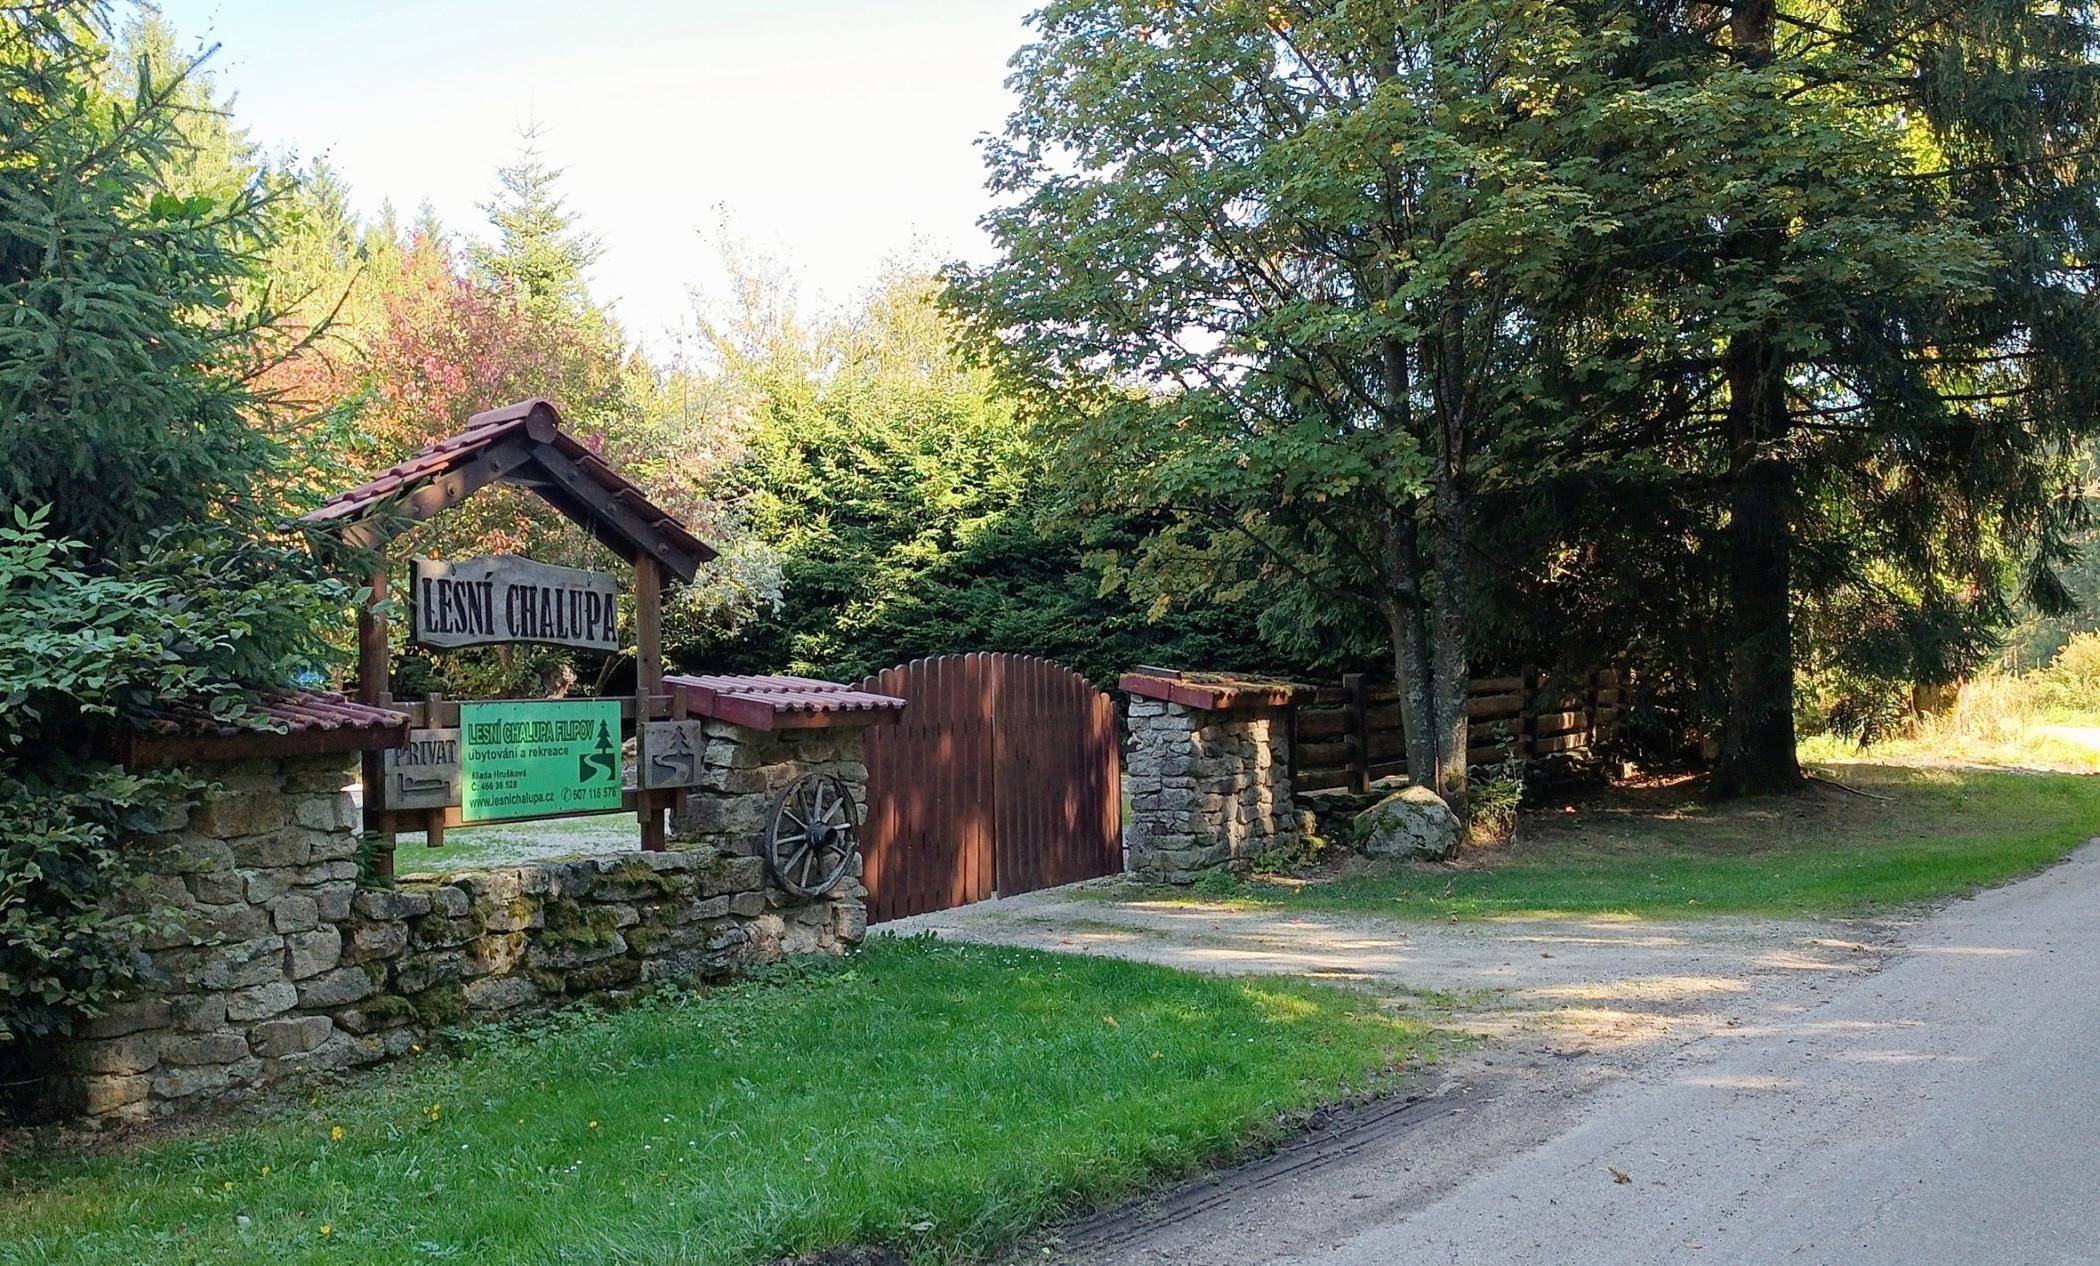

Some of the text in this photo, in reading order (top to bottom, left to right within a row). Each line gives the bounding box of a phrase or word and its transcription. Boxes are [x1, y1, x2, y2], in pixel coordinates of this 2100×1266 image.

[422, 572, 617, 642] LESNÍ CHALUPA
[468, 719, 594, 745] LESNÍ CHALUPA FILIPOV
[393, 740, 456, 767] PRIVAT
[468, 745, 569, 763] ubytování a rekreace
[494, 769, 527, 779] Hrušková
[469, 792, 554, 808] www.lesnichalupa.cz
[572, 788, 587, 800] 607
